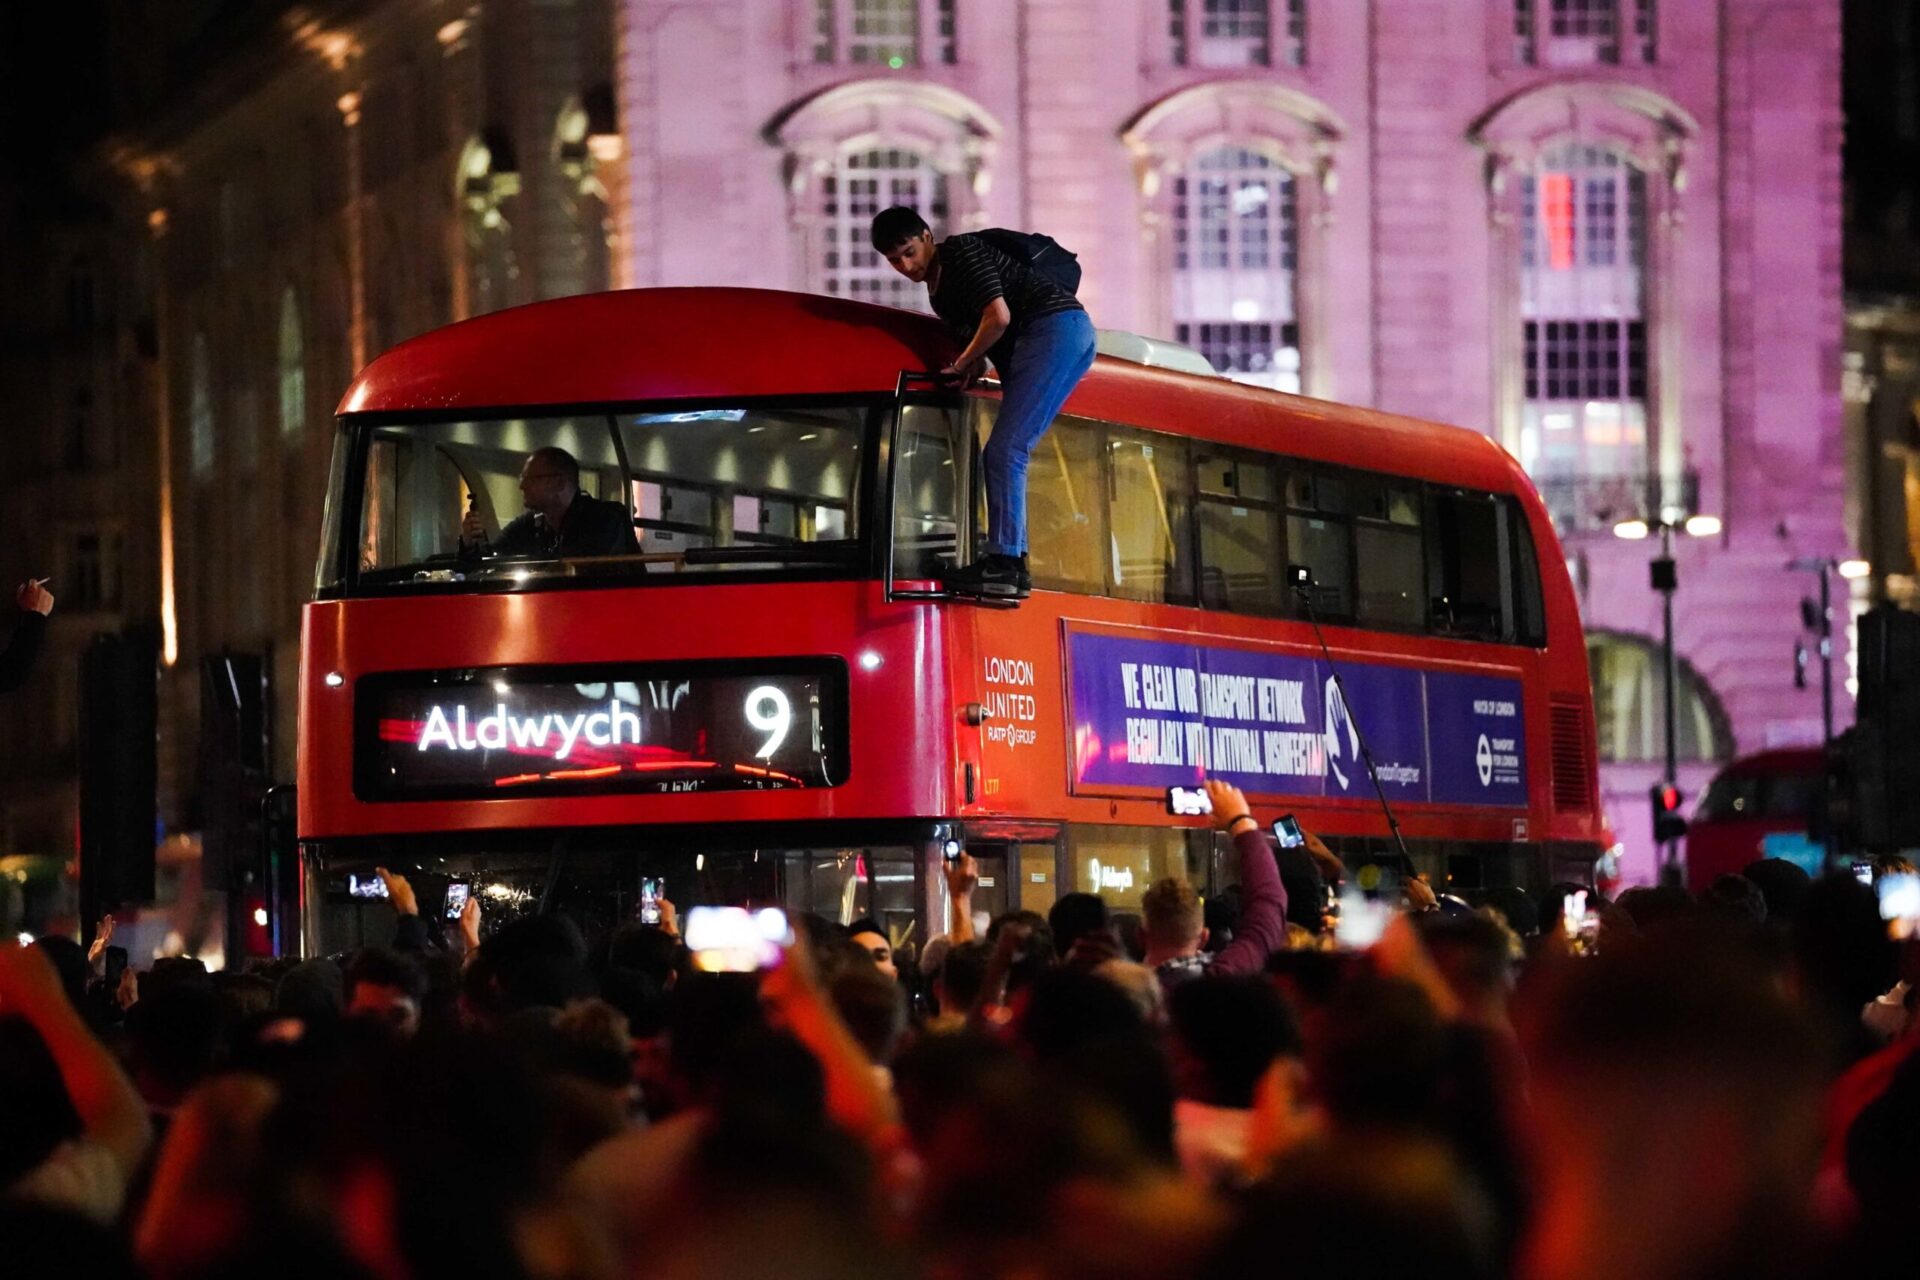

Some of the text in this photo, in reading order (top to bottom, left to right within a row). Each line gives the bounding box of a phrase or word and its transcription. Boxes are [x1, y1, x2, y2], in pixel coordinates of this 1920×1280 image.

[984, 656, 1034, 687] LONDON
[1121, 662, 1306, 724] WE CLEAN OUR TRANSPORT NETWORK
[418, 685, 790, 760] Aldwych 9
[985, 691, 1036, 721] UNITED
[987, 726, 1037, 745] RATP GROUP
[1126, 717, 1183, 766] REGULARLY
[1185, 721, 1212, 771] WITH
[1212, 726, 1264, 774] ANTIVIRAL
